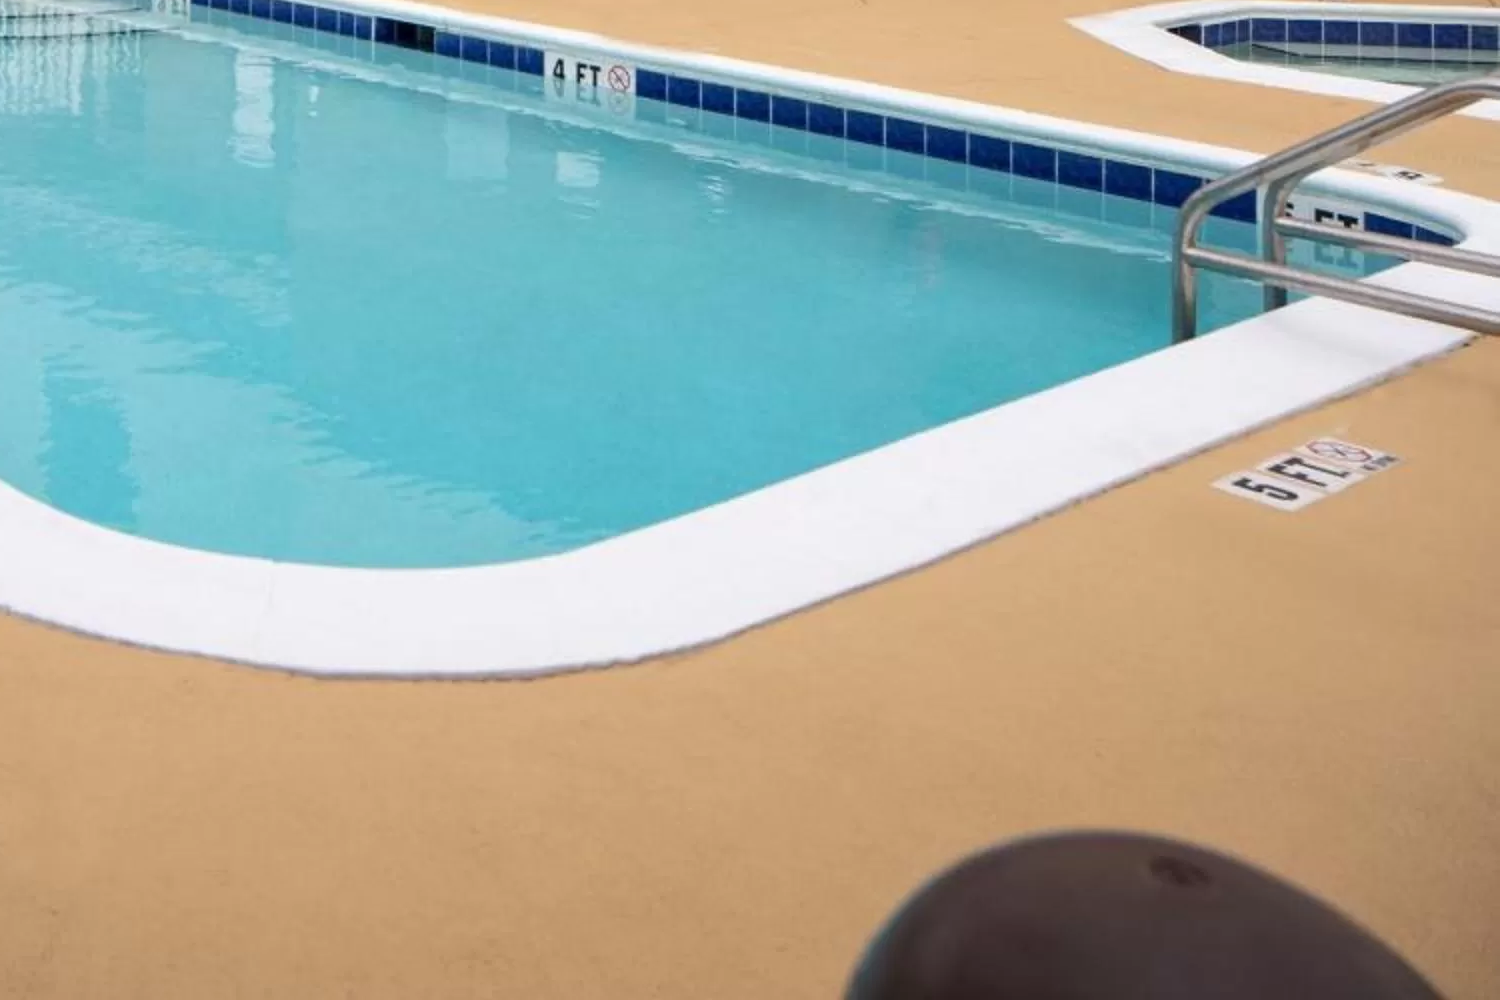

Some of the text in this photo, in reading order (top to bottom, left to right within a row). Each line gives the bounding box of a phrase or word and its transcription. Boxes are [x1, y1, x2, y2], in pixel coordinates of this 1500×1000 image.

[553, 58, 601, 86] 4 FT
[1232, 475, 1299, 501] 5
[1268, 456, 1351, 488] FT
